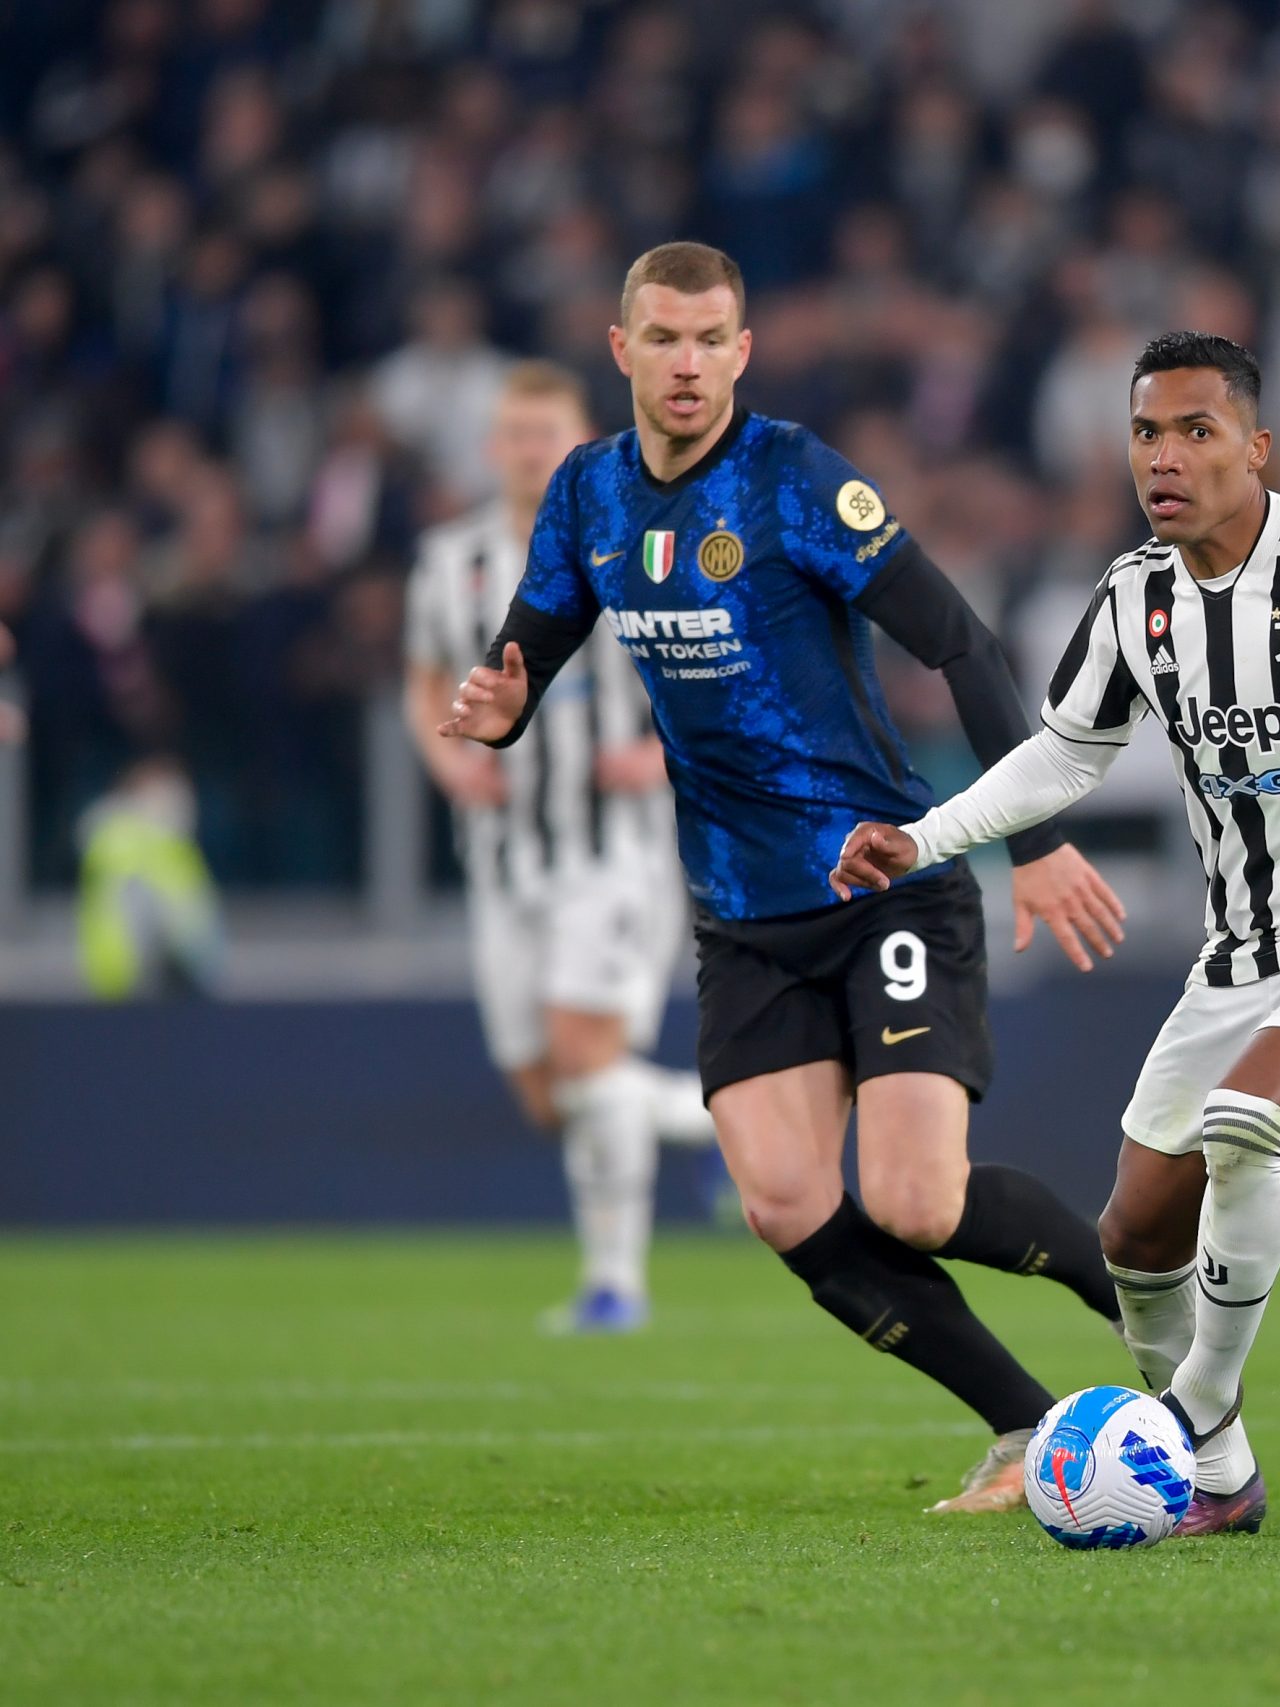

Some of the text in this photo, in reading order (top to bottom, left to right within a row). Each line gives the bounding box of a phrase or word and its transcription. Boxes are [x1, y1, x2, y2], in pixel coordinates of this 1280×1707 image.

[655, 638, 742, 660] TOKEN
[661, 660, 751, 680] by socios.com
[1151, 662, 1180, 675] adidas
[880, 930, 927, 1001] 9
